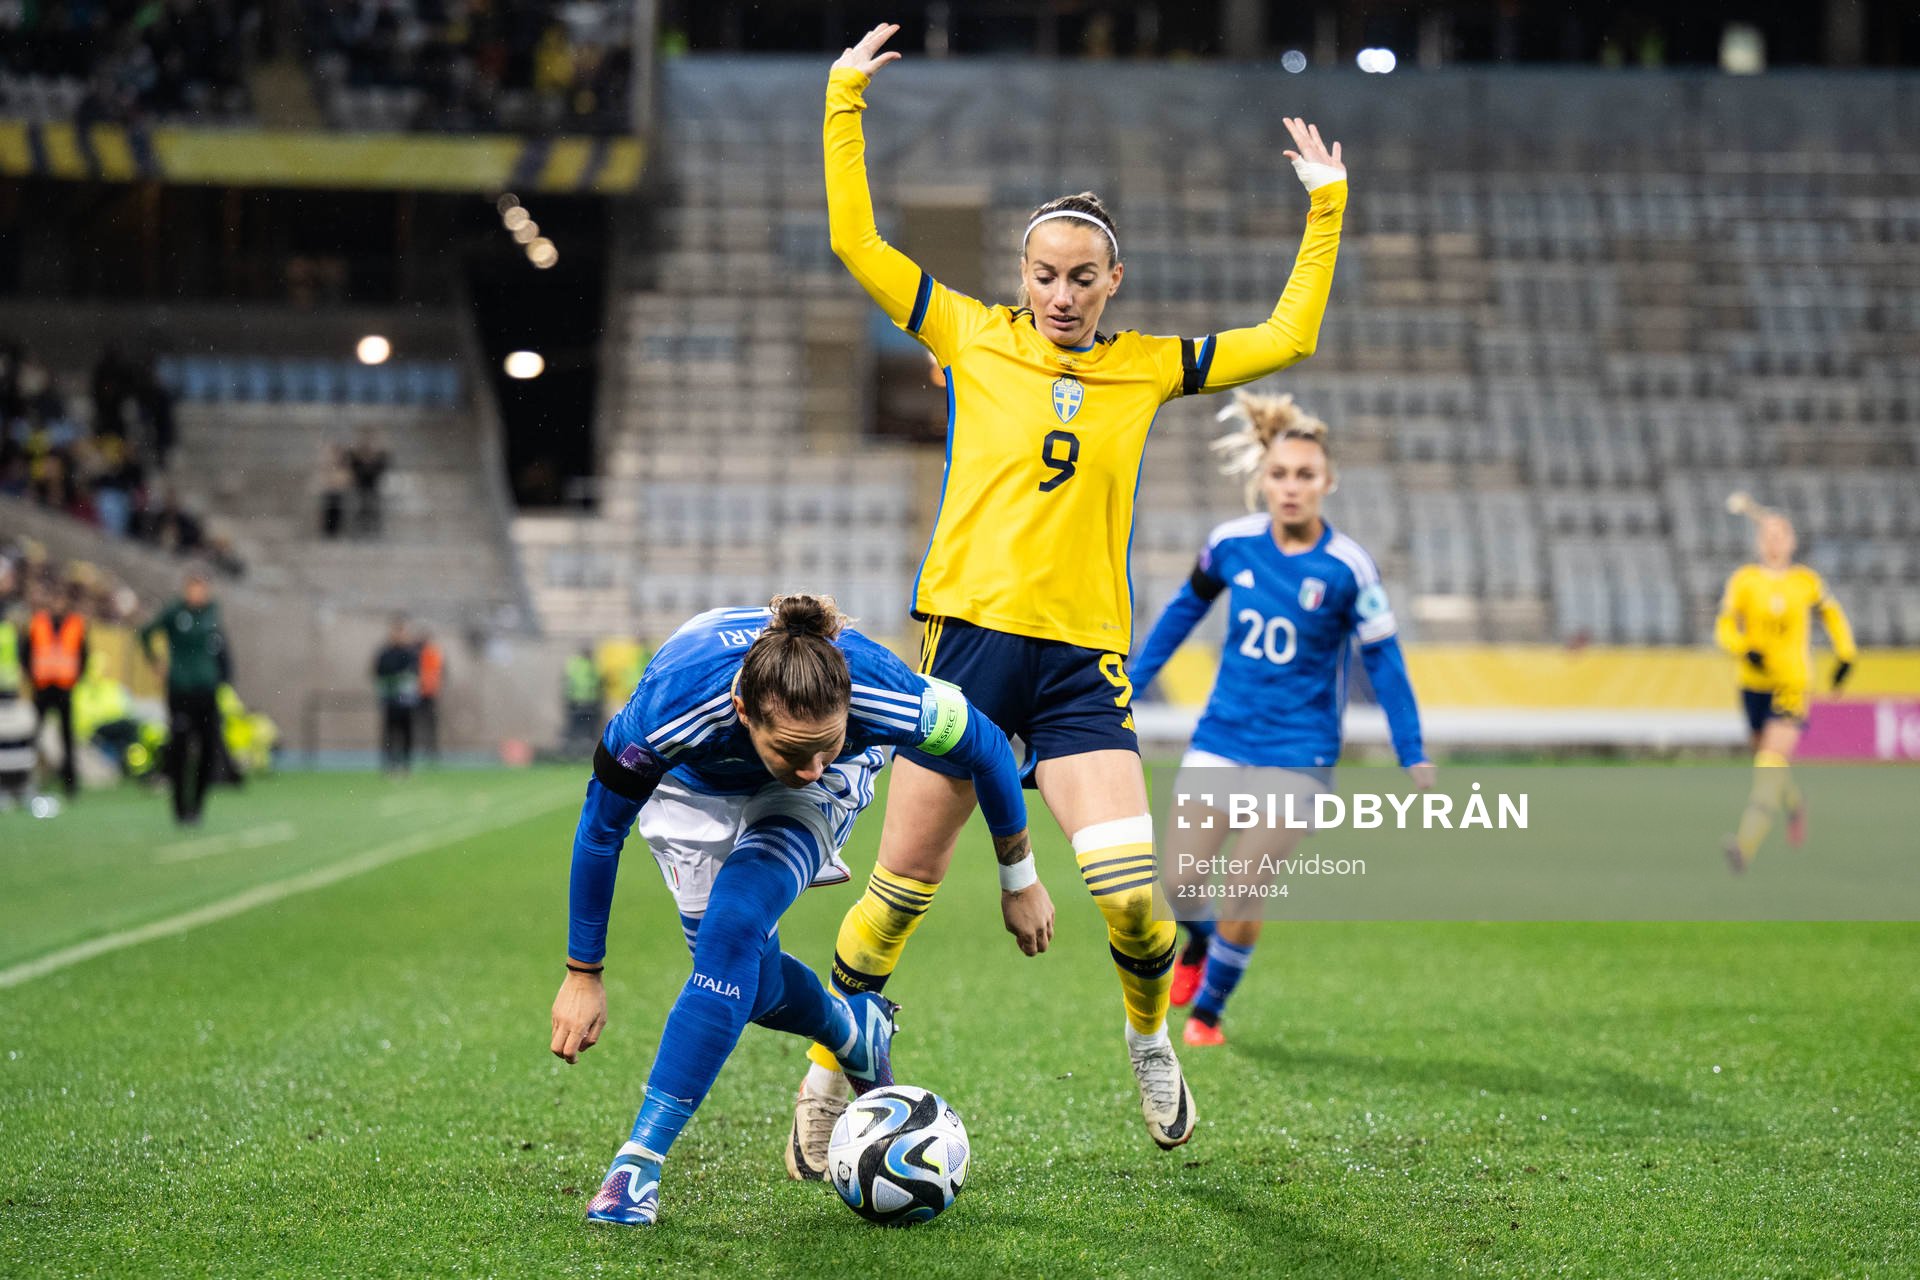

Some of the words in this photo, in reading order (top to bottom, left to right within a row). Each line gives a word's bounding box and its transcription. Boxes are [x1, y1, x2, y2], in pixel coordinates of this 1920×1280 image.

[1038, 429, 1080, 493] 9
[1238, 608, 1297, 665] 20
[1098, 653, 1133, 708] 9
[693, 972, 740, 1000] ITALIA
[832, 961, 869, 992] ERIGE
